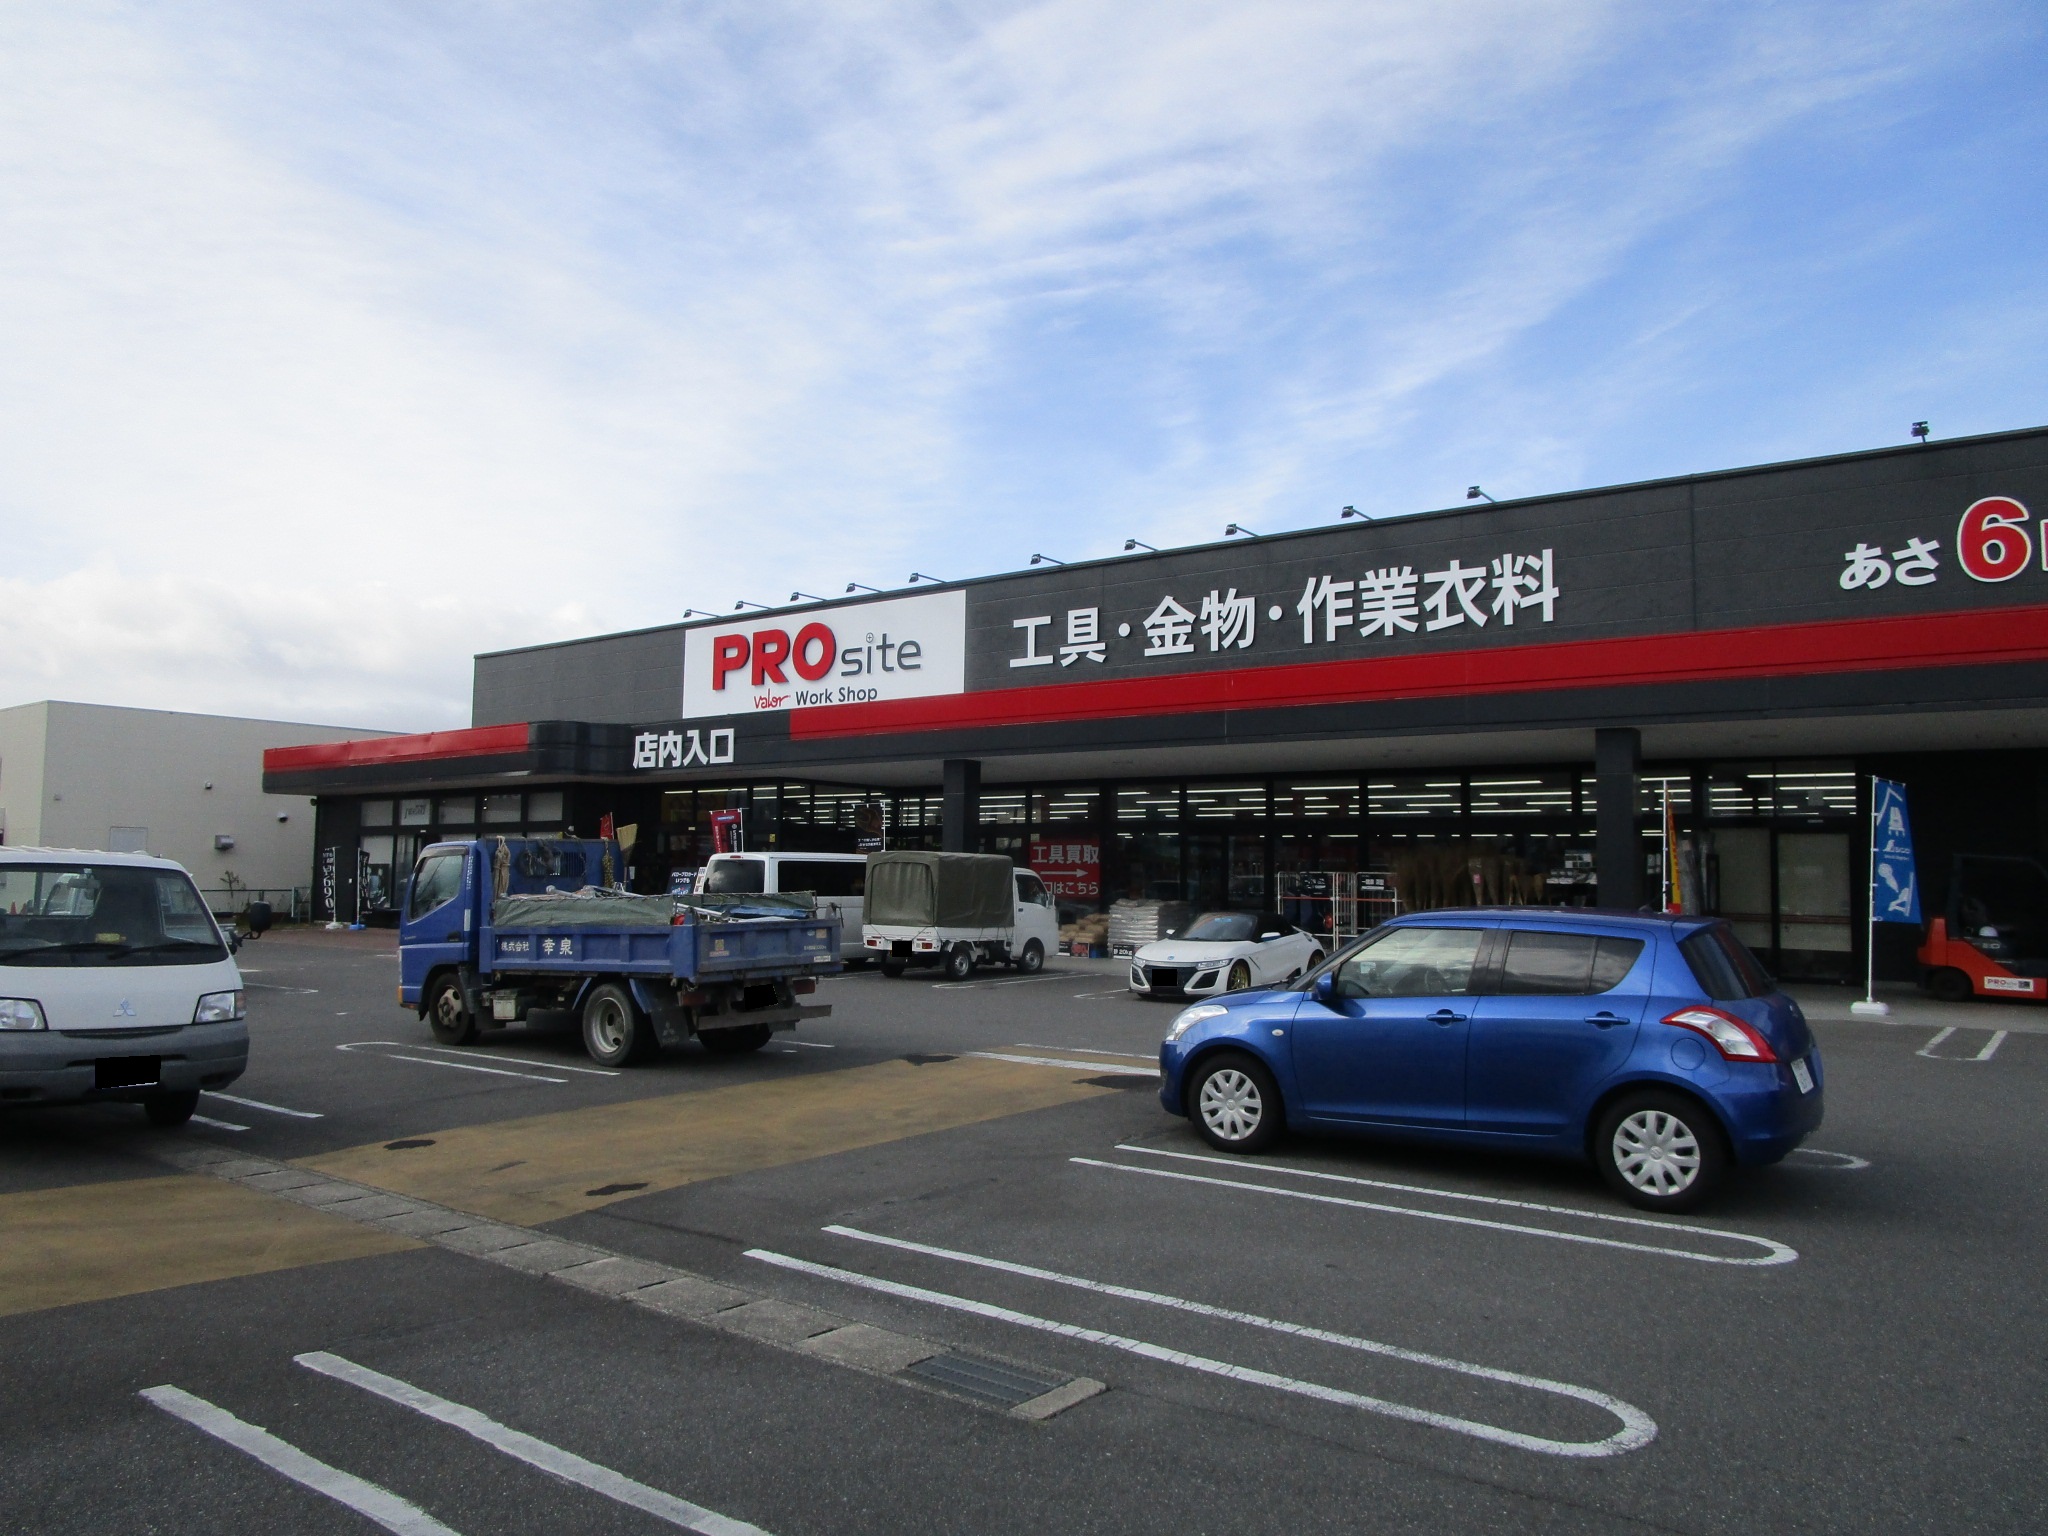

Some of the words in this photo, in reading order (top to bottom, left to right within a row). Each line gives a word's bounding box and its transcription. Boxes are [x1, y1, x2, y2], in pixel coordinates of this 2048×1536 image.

[1010, 549, 1560, 668] 工具・金物・作業衣料
[796, 689, 833, 706] Work
[838, 686, 878, 702] Shop
[633, 728, 735, 769] 店内入口
[1032, 845, 1099, 864] 工具買取
[500, 941, 530, 952] 株式会社
[542, 937, 573, 955] 幸泉
